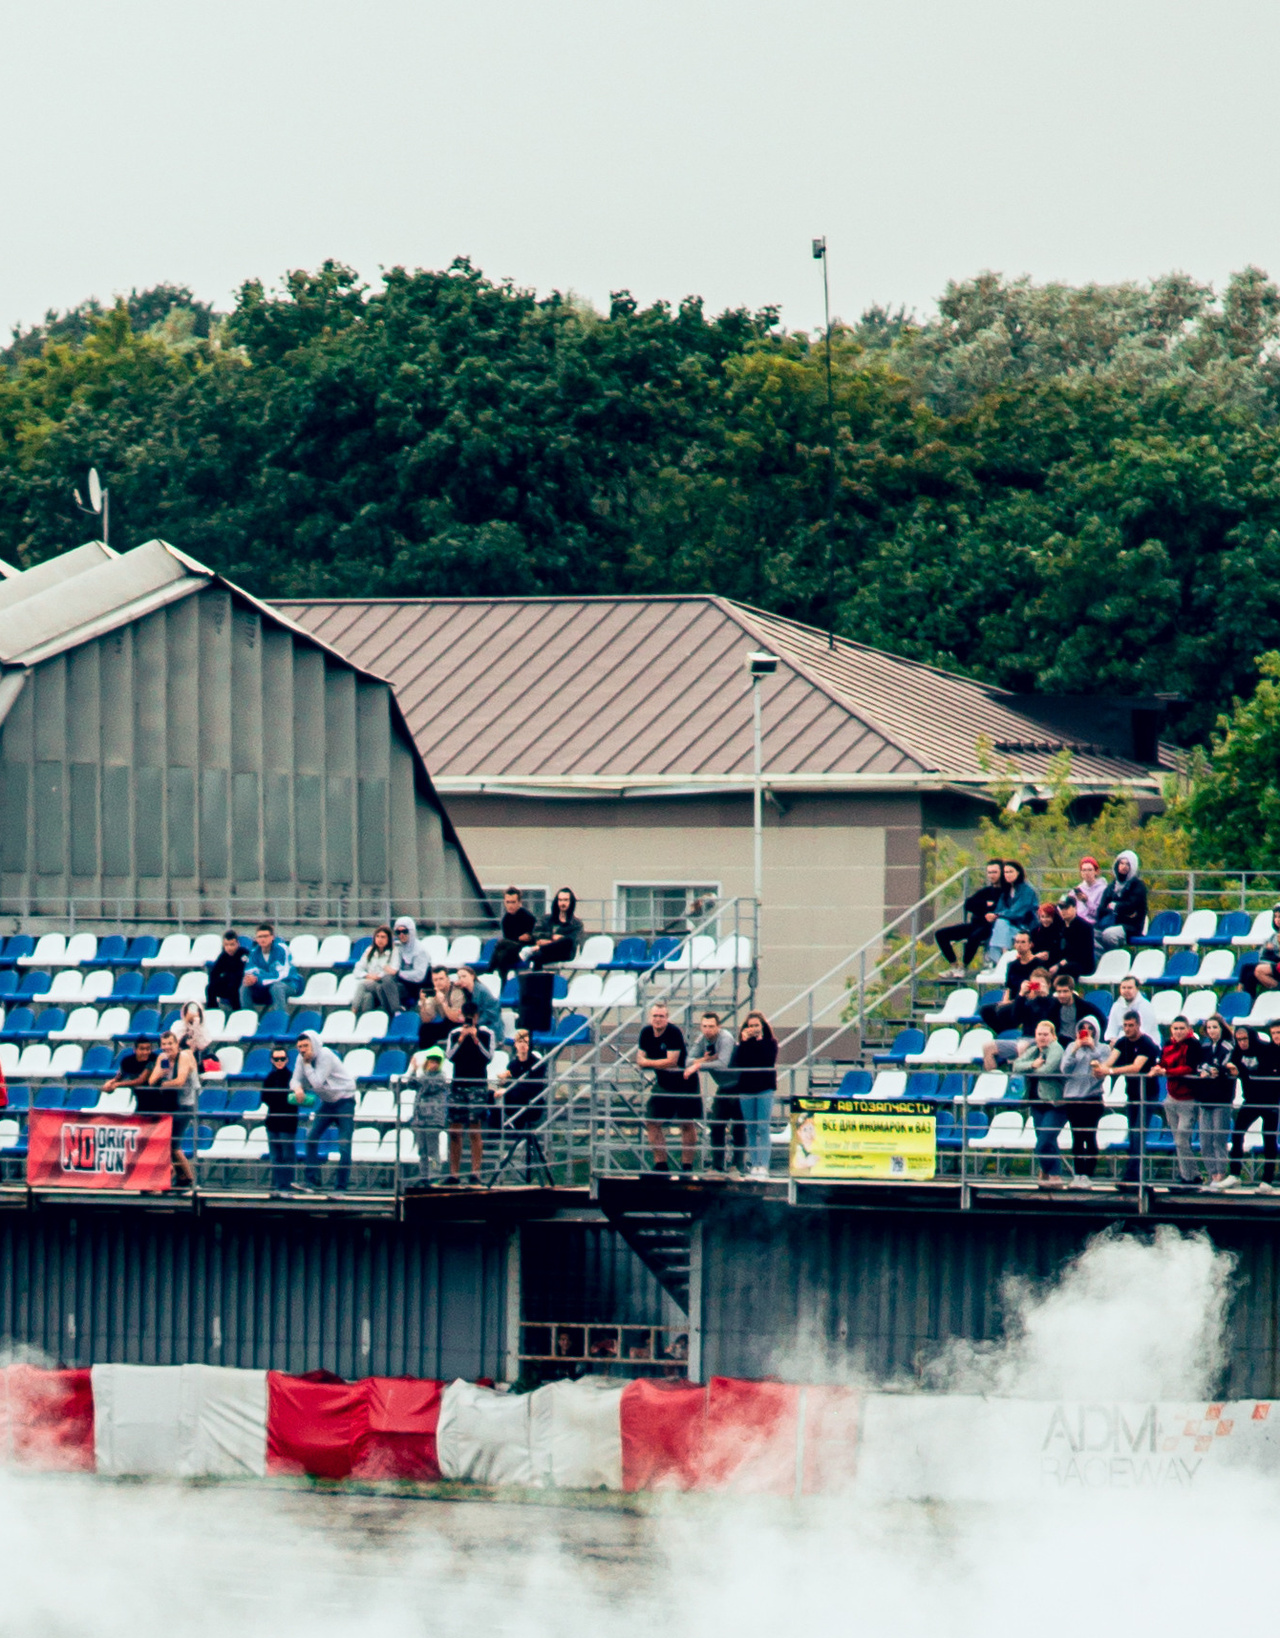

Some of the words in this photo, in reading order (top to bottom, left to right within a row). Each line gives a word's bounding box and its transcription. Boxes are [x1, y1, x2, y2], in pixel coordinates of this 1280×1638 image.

[63, 1125, 97, 1172] NO
[97, 1127, 139, 1150] DRIFT
[97, 1150, 125, 1172] FUN
[1041, 1404, 1157, 1453] ADM
[1040, 1456, 1202, 1488] RACEWAY
